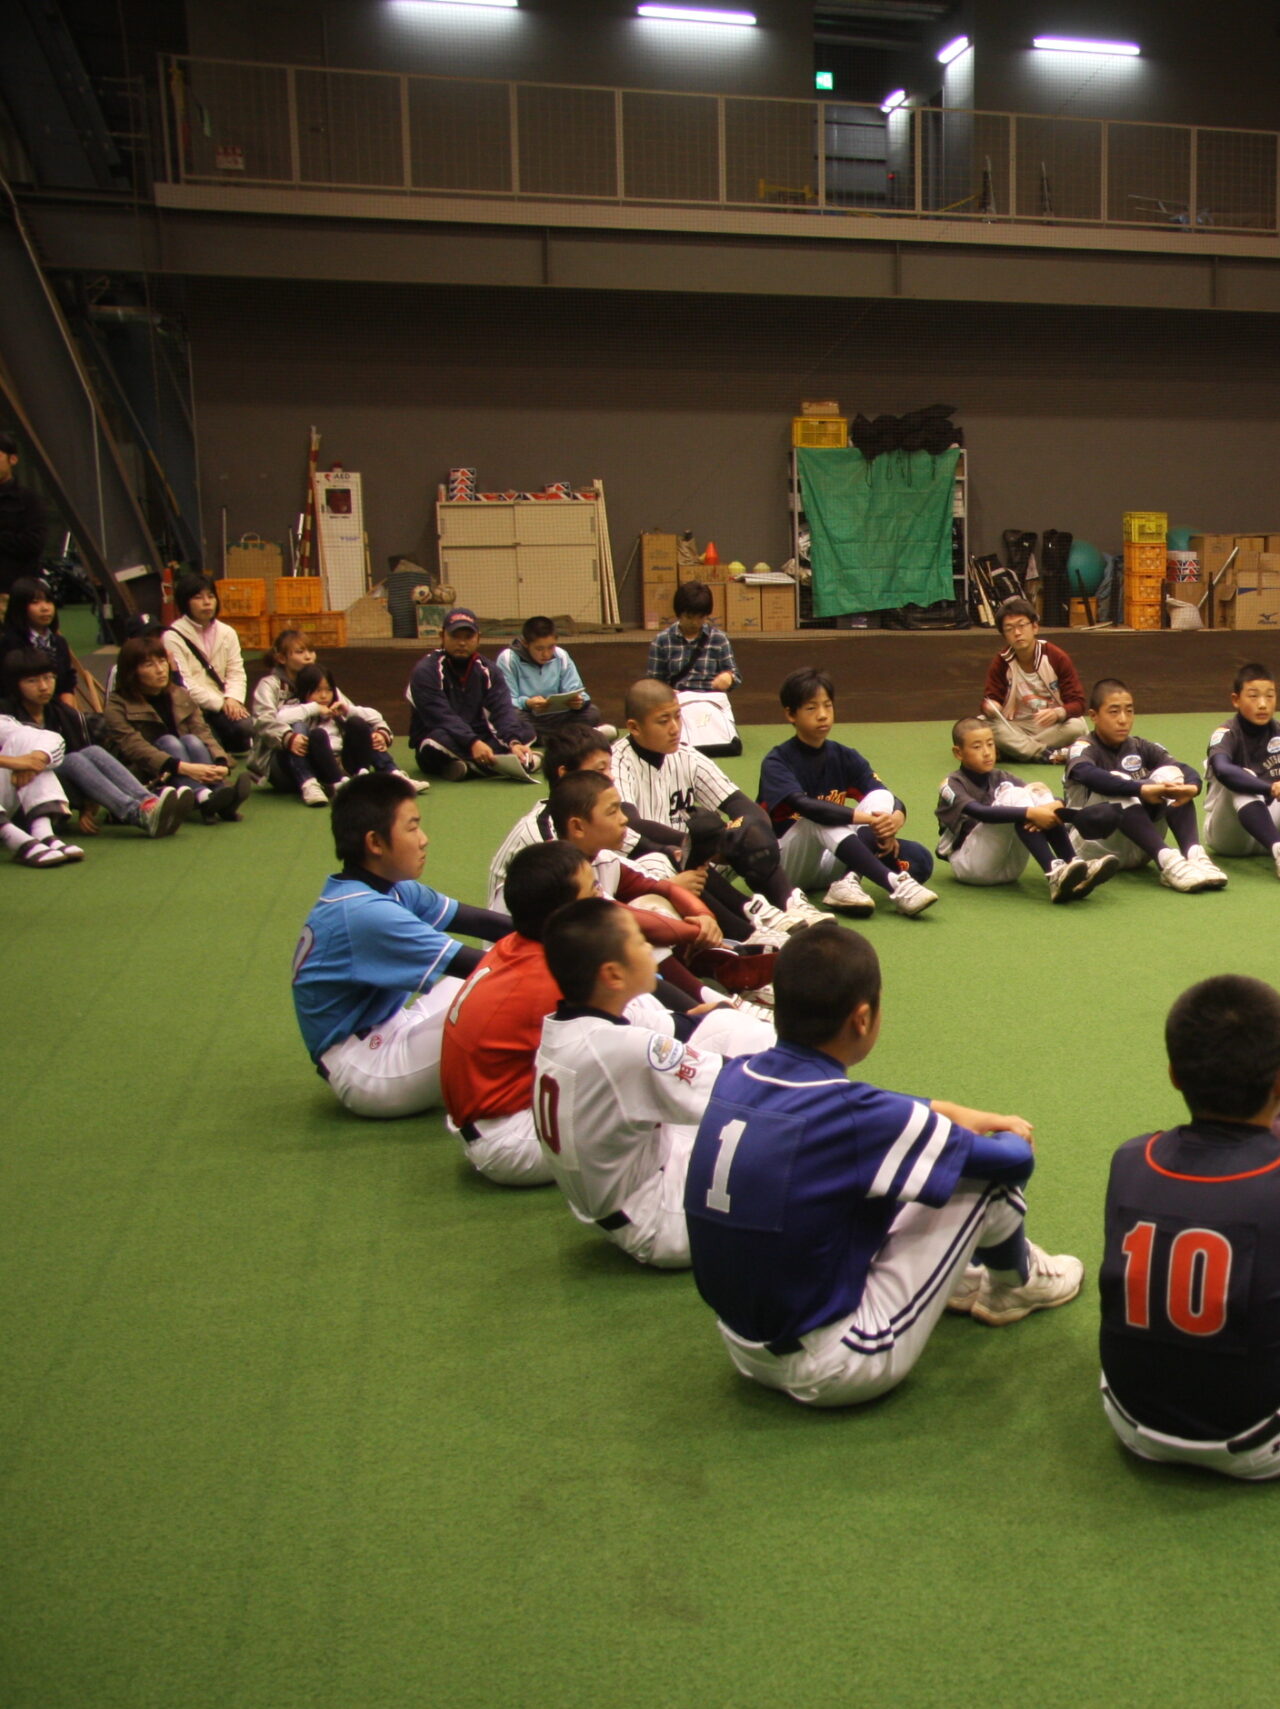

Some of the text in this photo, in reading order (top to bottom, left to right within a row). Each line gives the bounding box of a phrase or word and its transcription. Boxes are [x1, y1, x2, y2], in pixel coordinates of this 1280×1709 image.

[532, 1072, 561, 1156] 0
[706, 1119, 748, 1214] 1
[1122, 1221, 1233, 1336] 10
